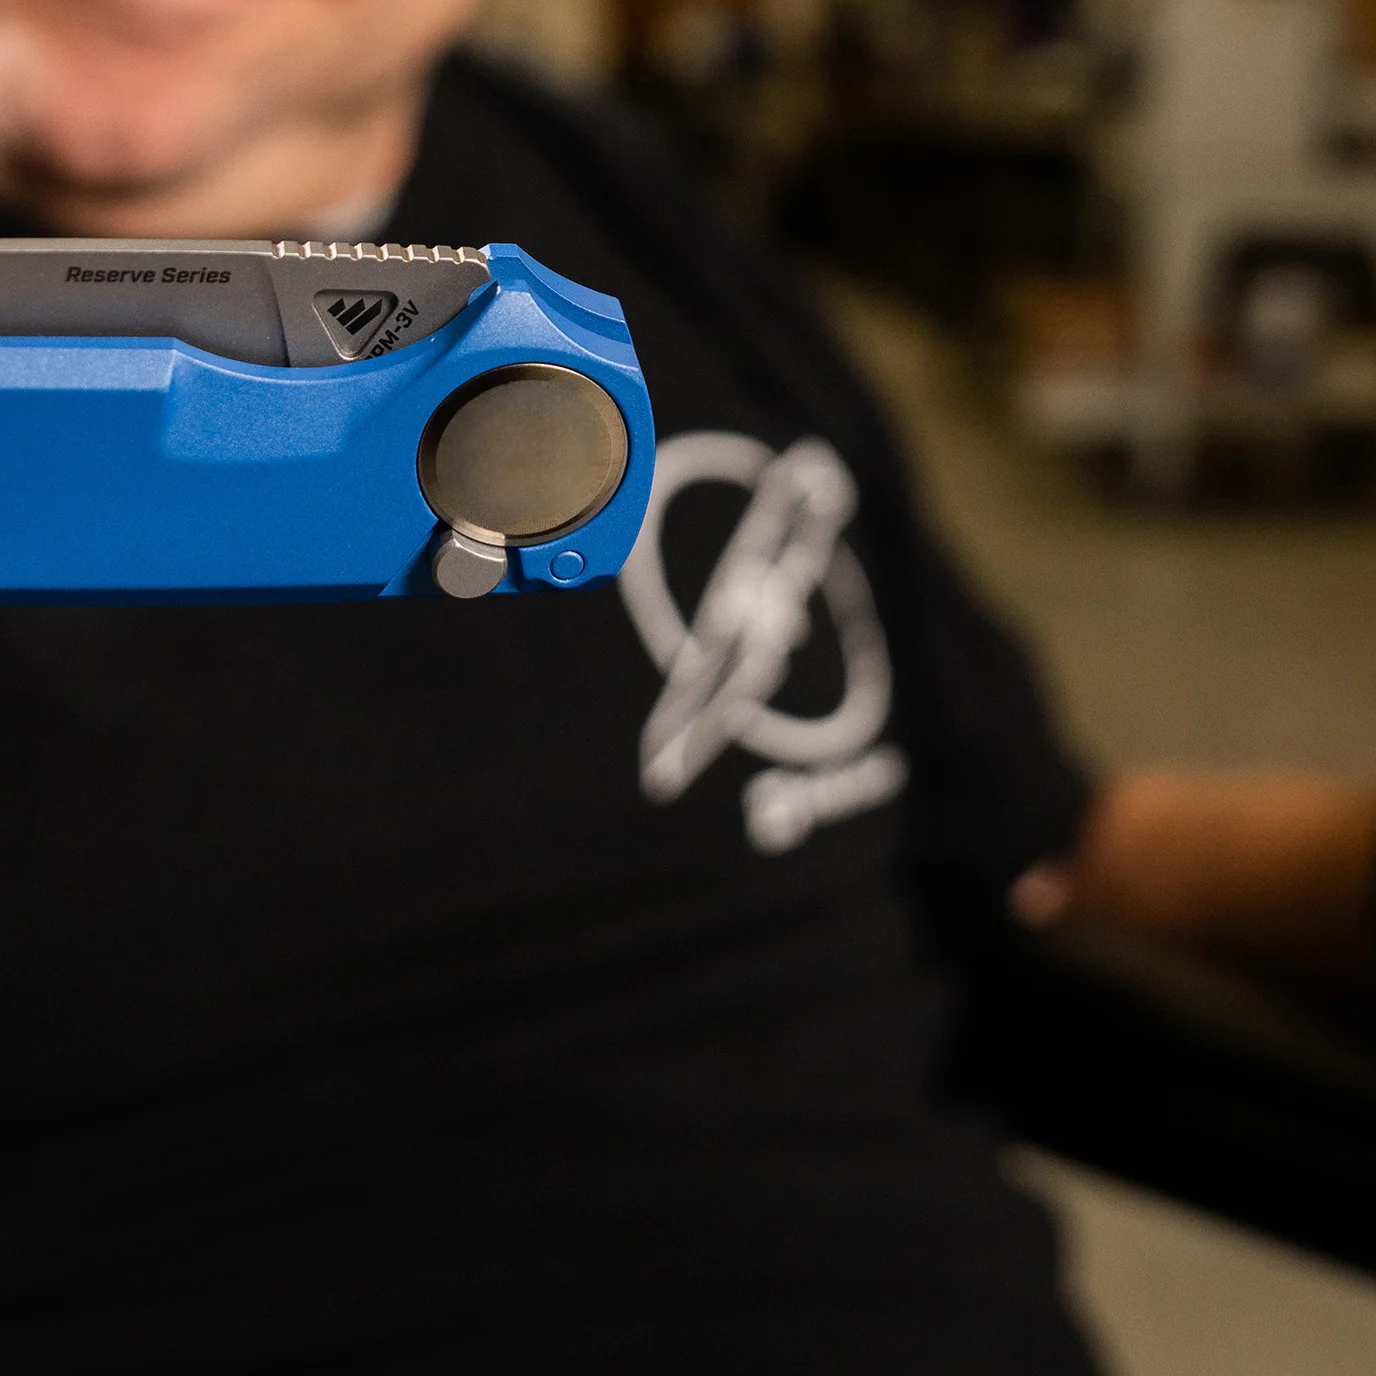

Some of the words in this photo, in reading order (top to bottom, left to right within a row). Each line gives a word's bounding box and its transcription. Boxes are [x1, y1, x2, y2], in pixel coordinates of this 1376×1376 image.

[66, 266, 156, 283] Reserve
[161, 267, 231, 283] Series
[365, 299, 419, 360] PM-3V
